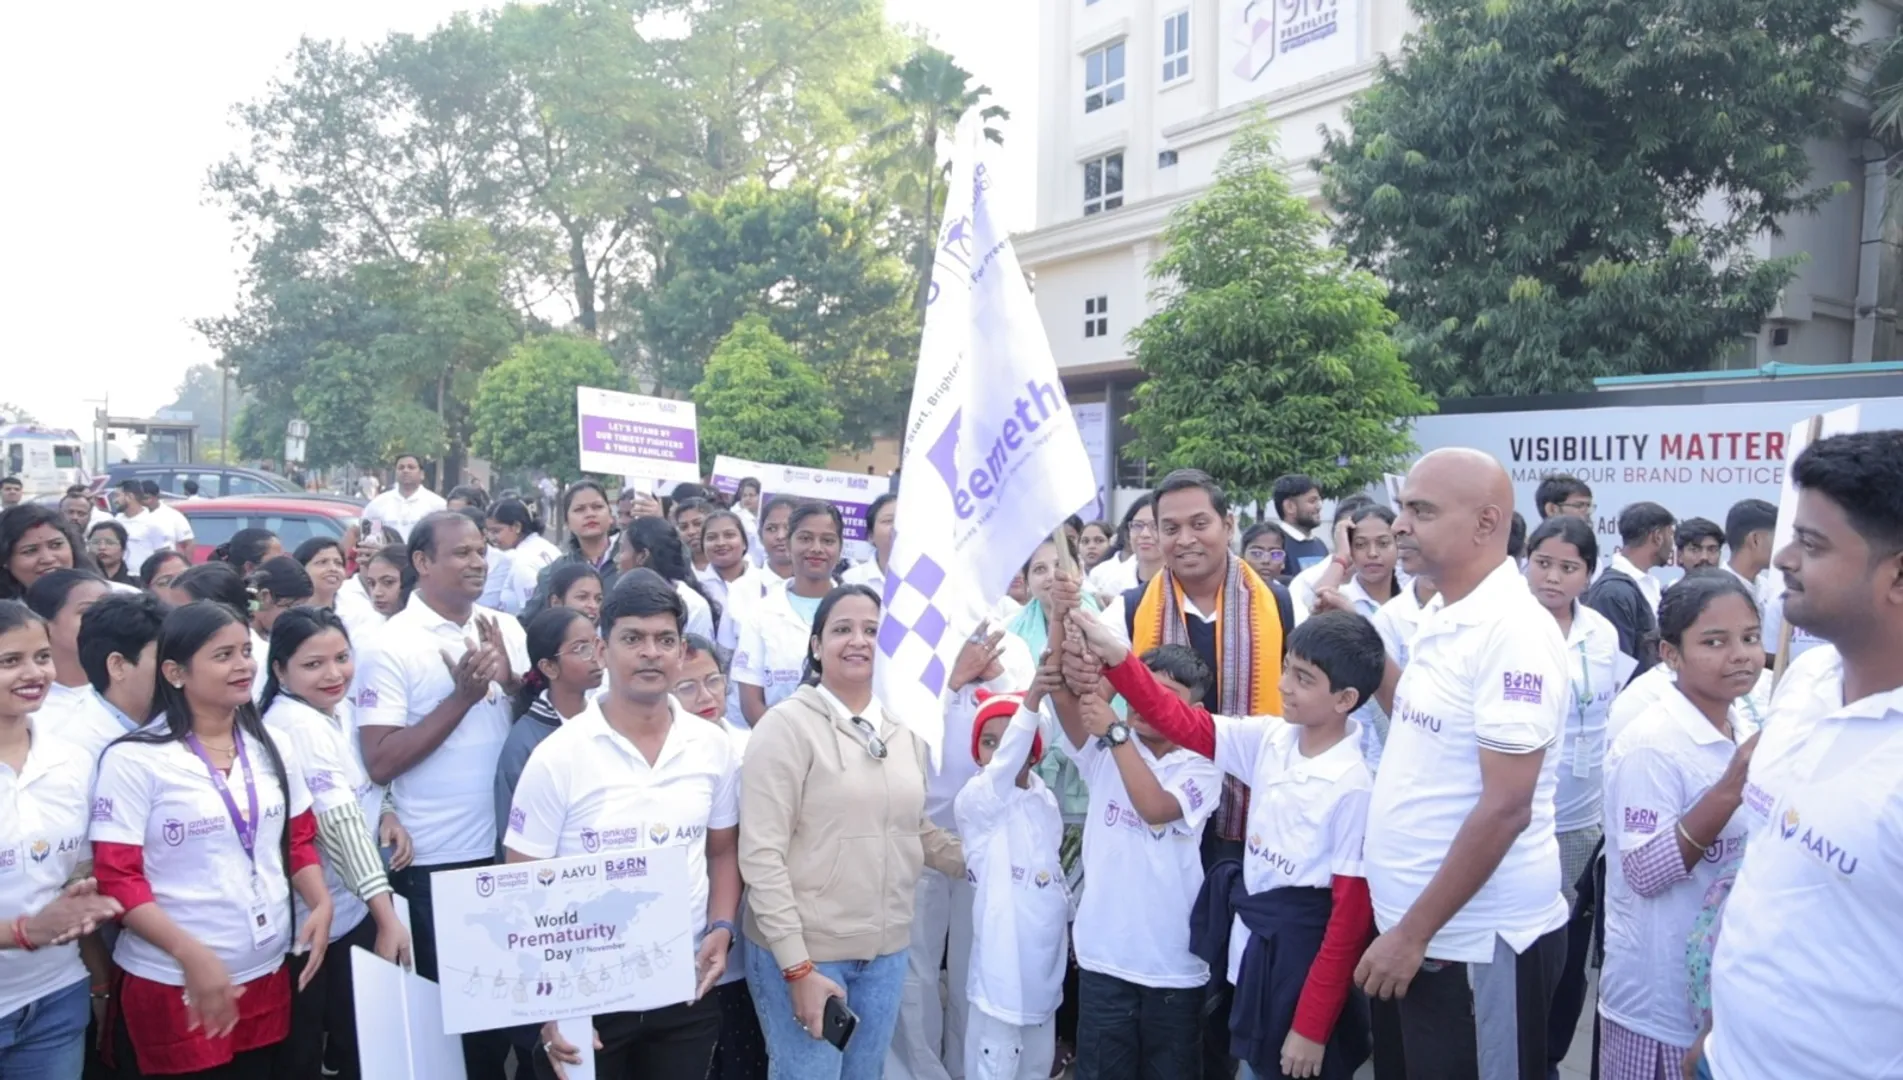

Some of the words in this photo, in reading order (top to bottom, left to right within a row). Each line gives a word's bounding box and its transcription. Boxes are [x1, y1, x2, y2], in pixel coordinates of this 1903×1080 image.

[595, 430, 613, 440] OUR
[646, 438, 685, 449] FIGHTERS
[633, 425, 658, 436] STAND
[660, 430, 671, 438] BY
[613, 443, 638, 454] THEIR
[1510, 434, 1649, 462] VISIBILITY
[1660, 432, 1786, 461] MATTER
[1566, 467, 1616, 483] YOUR
[1624, 467, 1693, 483] BRAND
[1504, 671, 1543, 690] BORN
[1800, 826, 1859, 875] AAYU
[605, 856, 647, 873] BORN
[1261, 847, 1296, 876] AAYU
[497, 871, 529, 881] ankura
[561, 864, 597, 880] AAYU
[534, 910, 579, 928] World
[507, 924, 617, 949] Prematurity
[544, 948, 573, 962] Day
[576, 947, 586, 955] 17
[586, 941, 626, 954] November
